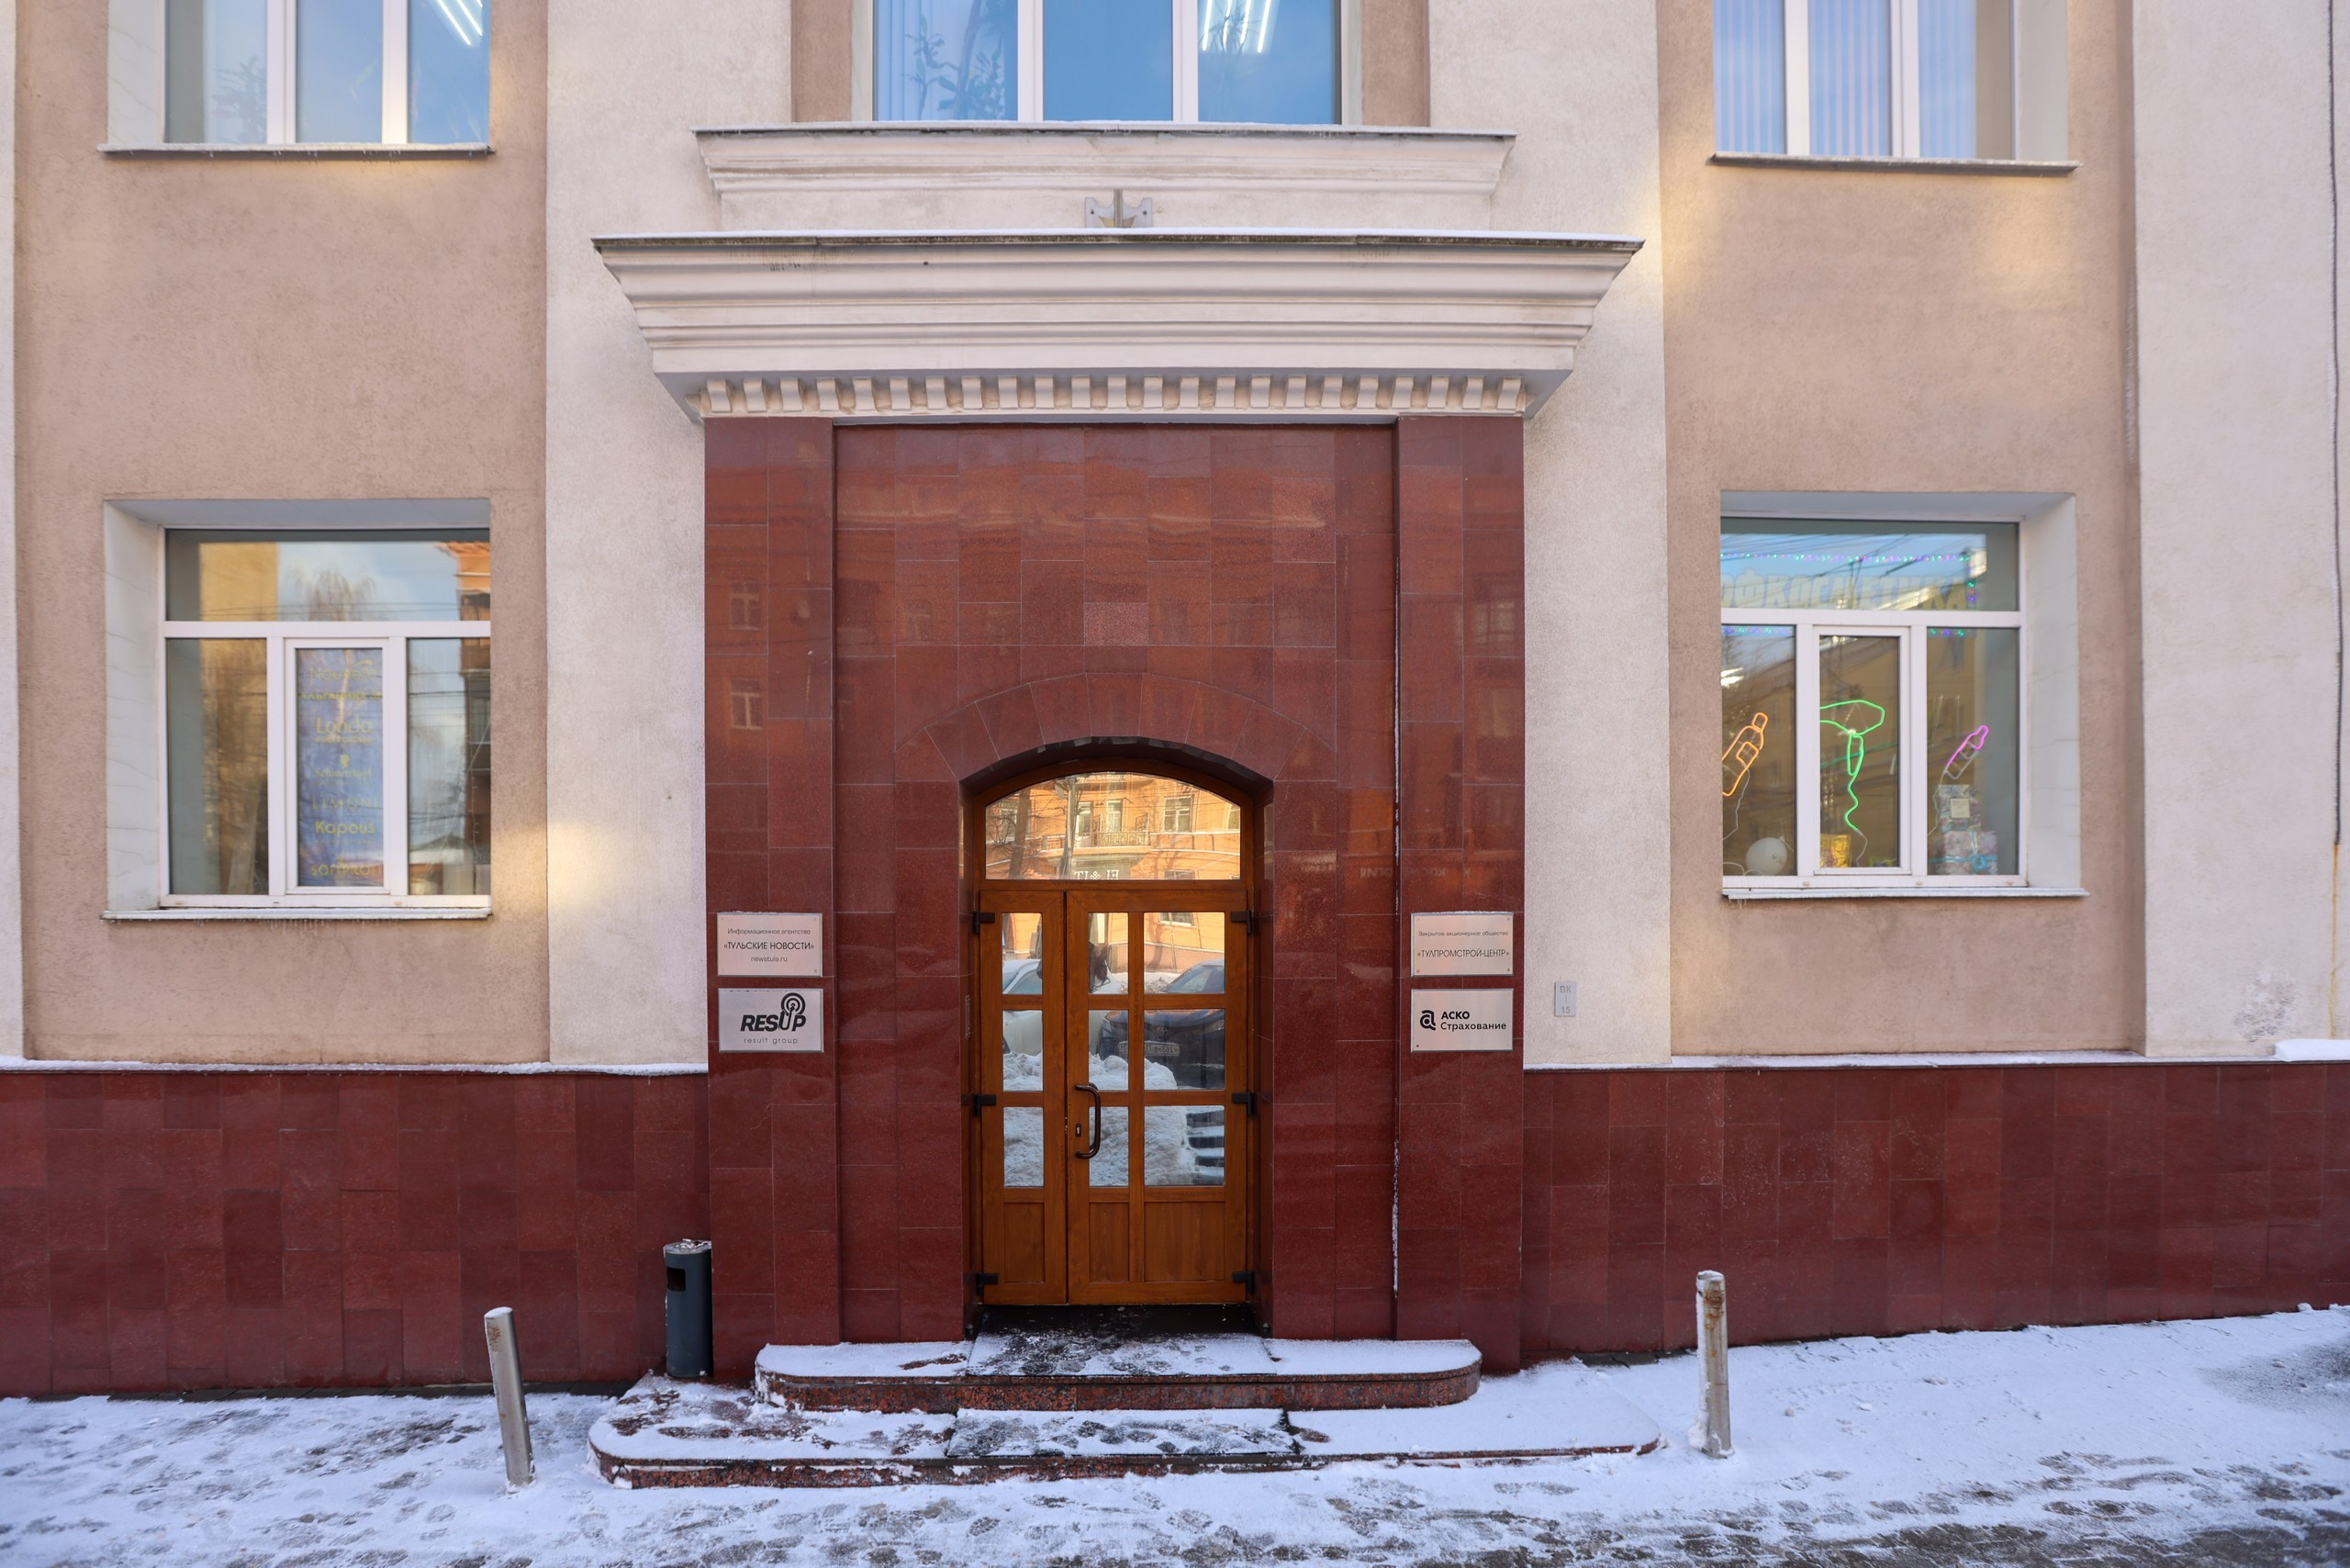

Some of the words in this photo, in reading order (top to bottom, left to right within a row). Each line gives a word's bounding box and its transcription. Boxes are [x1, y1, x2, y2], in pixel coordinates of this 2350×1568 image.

[316, 714, 372, 734] Londa
[315, 822, 375, 837] Kapous
[724, 942, 768, 950] «ТУЛЬСКИЕ
[769, 942, 814, 950] НОВОСТИ»
[1416, 947, 1510, 958] «ТУЛПРОМСТРОЙ-ЦЕНТР»
[740, 1006, 807, 1032] RESUP
[1440, 1011, 1471, 1020] АСКО
[1440, 1022, 1506, 1032] Страхование
